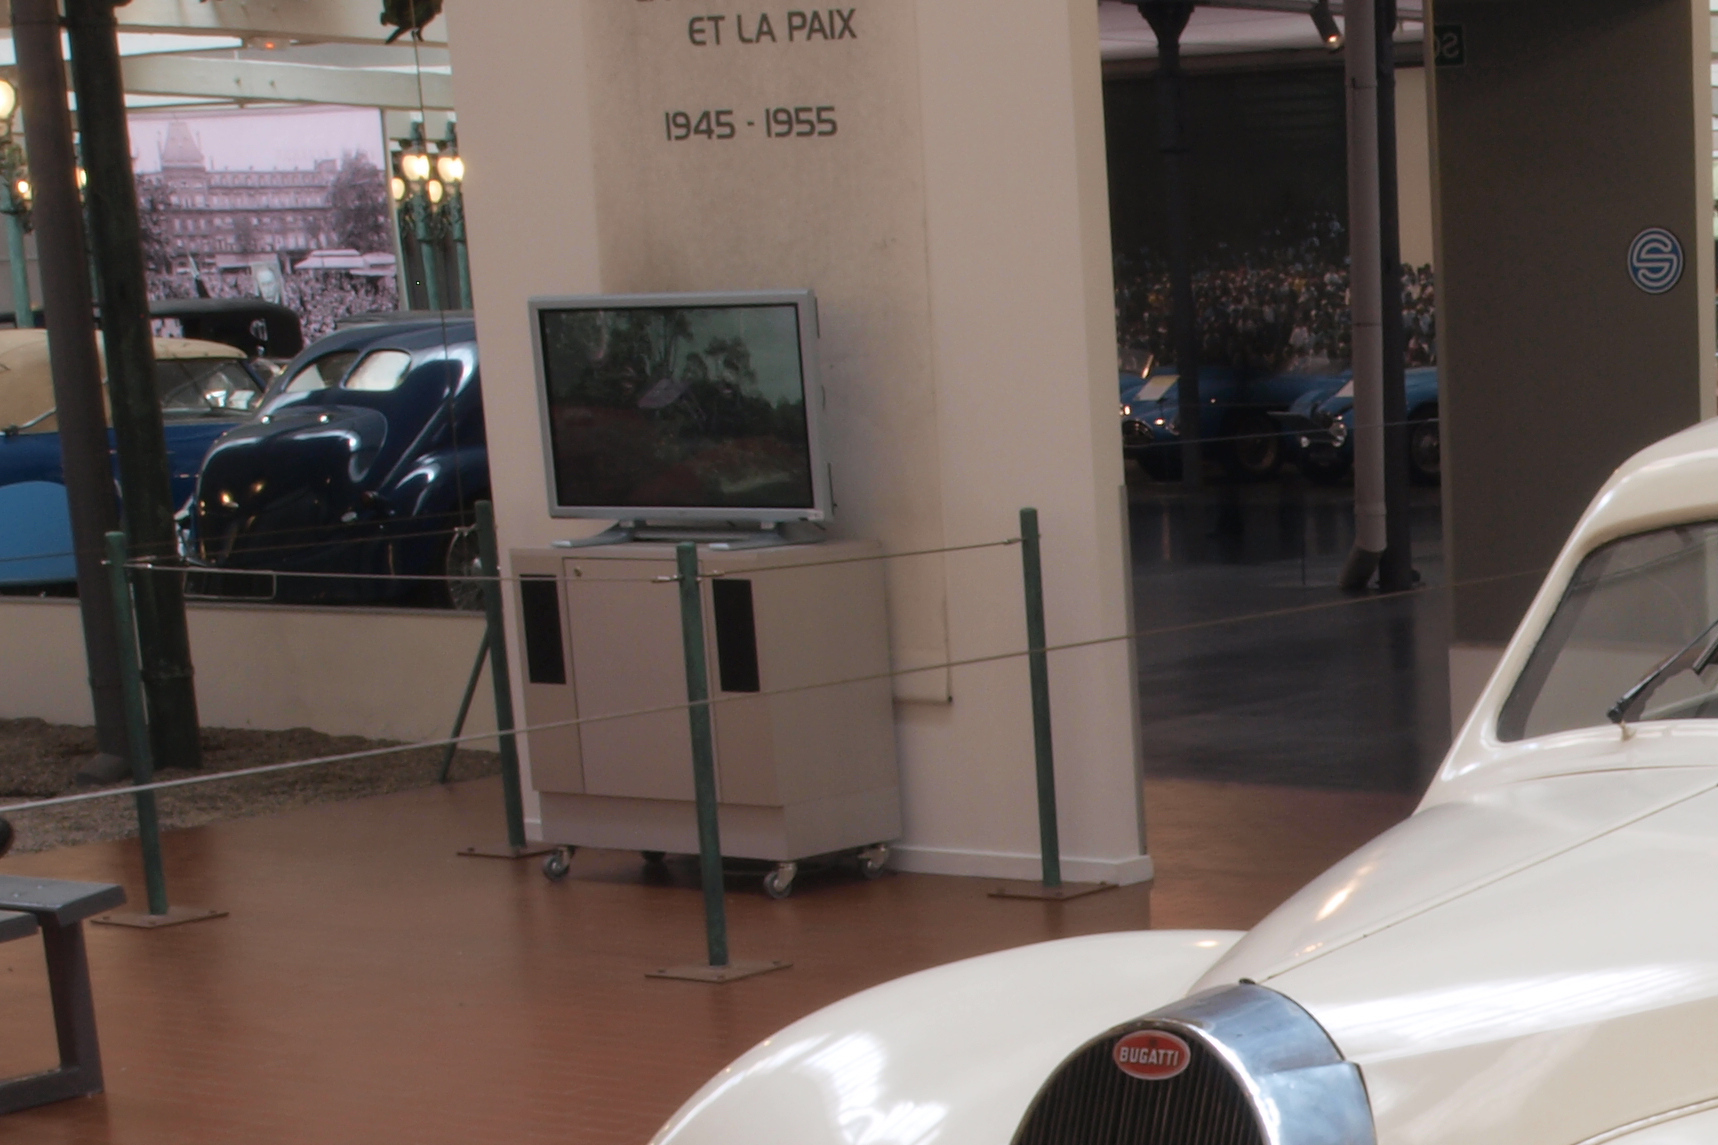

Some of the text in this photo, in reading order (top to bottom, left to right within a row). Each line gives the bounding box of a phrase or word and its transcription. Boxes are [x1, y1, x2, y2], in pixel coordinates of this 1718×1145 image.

[688, 8, 858, 46] ET LA PAIX
[665, 109, 736, 141] 1945
[764, 106, 838, 138] 1955
[1120, 1046, 1180, 1067] BUGATTI
